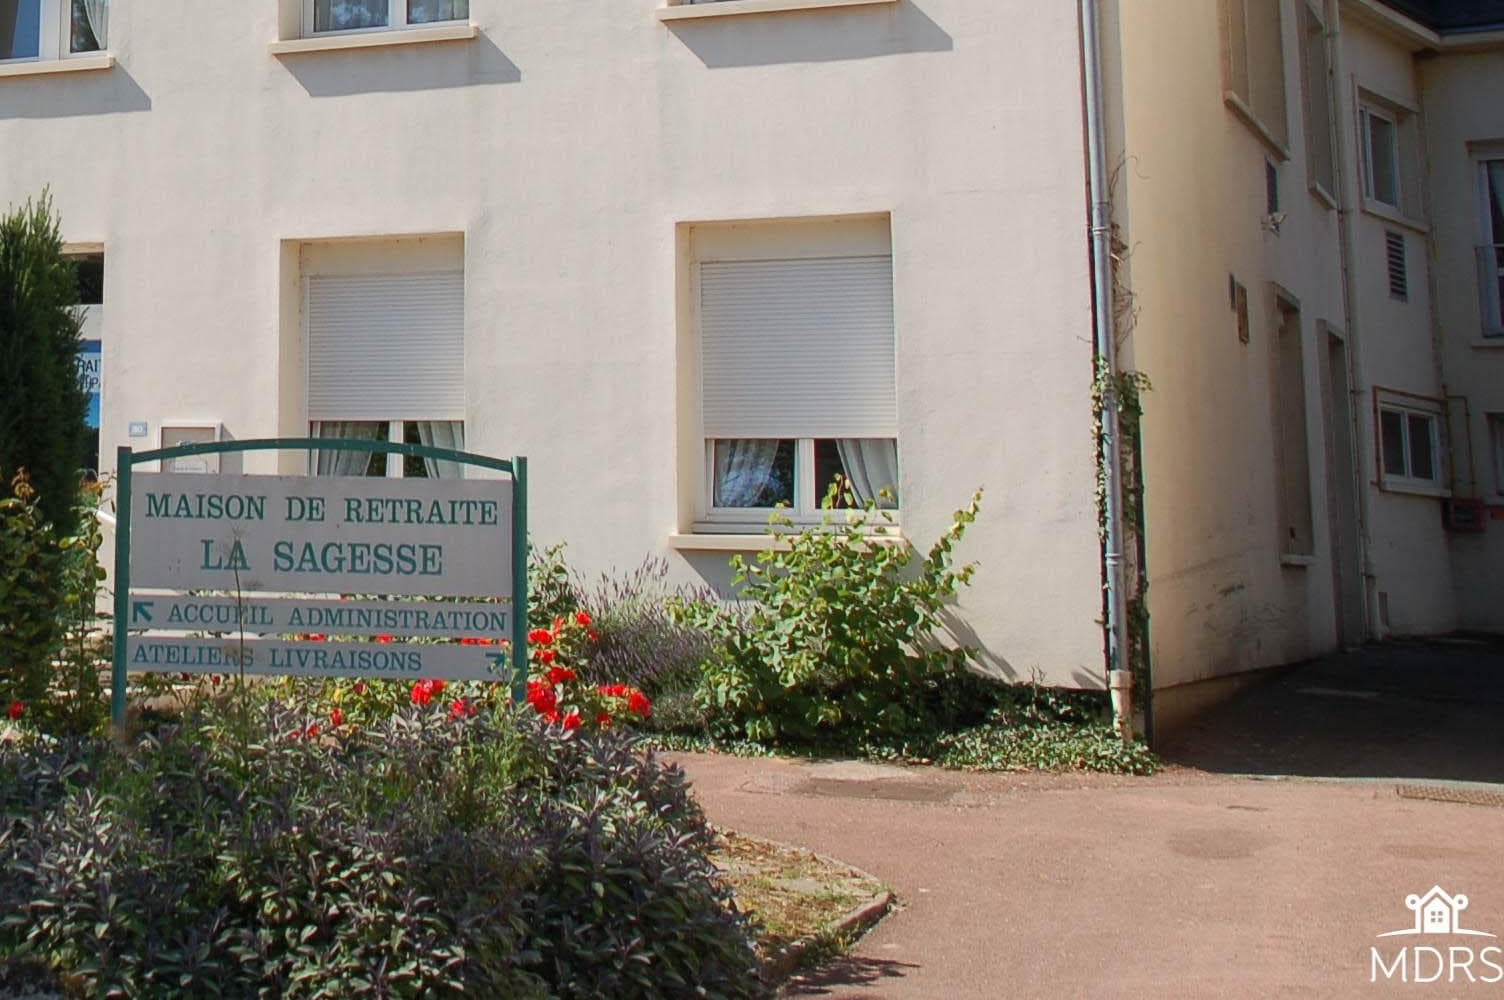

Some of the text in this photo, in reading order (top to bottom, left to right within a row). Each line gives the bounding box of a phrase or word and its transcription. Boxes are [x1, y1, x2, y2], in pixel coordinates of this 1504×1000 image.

[145, 493, 498, 526] MAISON DE RETRAITE
[200, 539, 443, 576] LA SAGESSE
[167, 604, 508, 632] ACCUEIL ADMINISTRATION
[131, 645, 423, 672] ATELIERS LIVRAISONS
